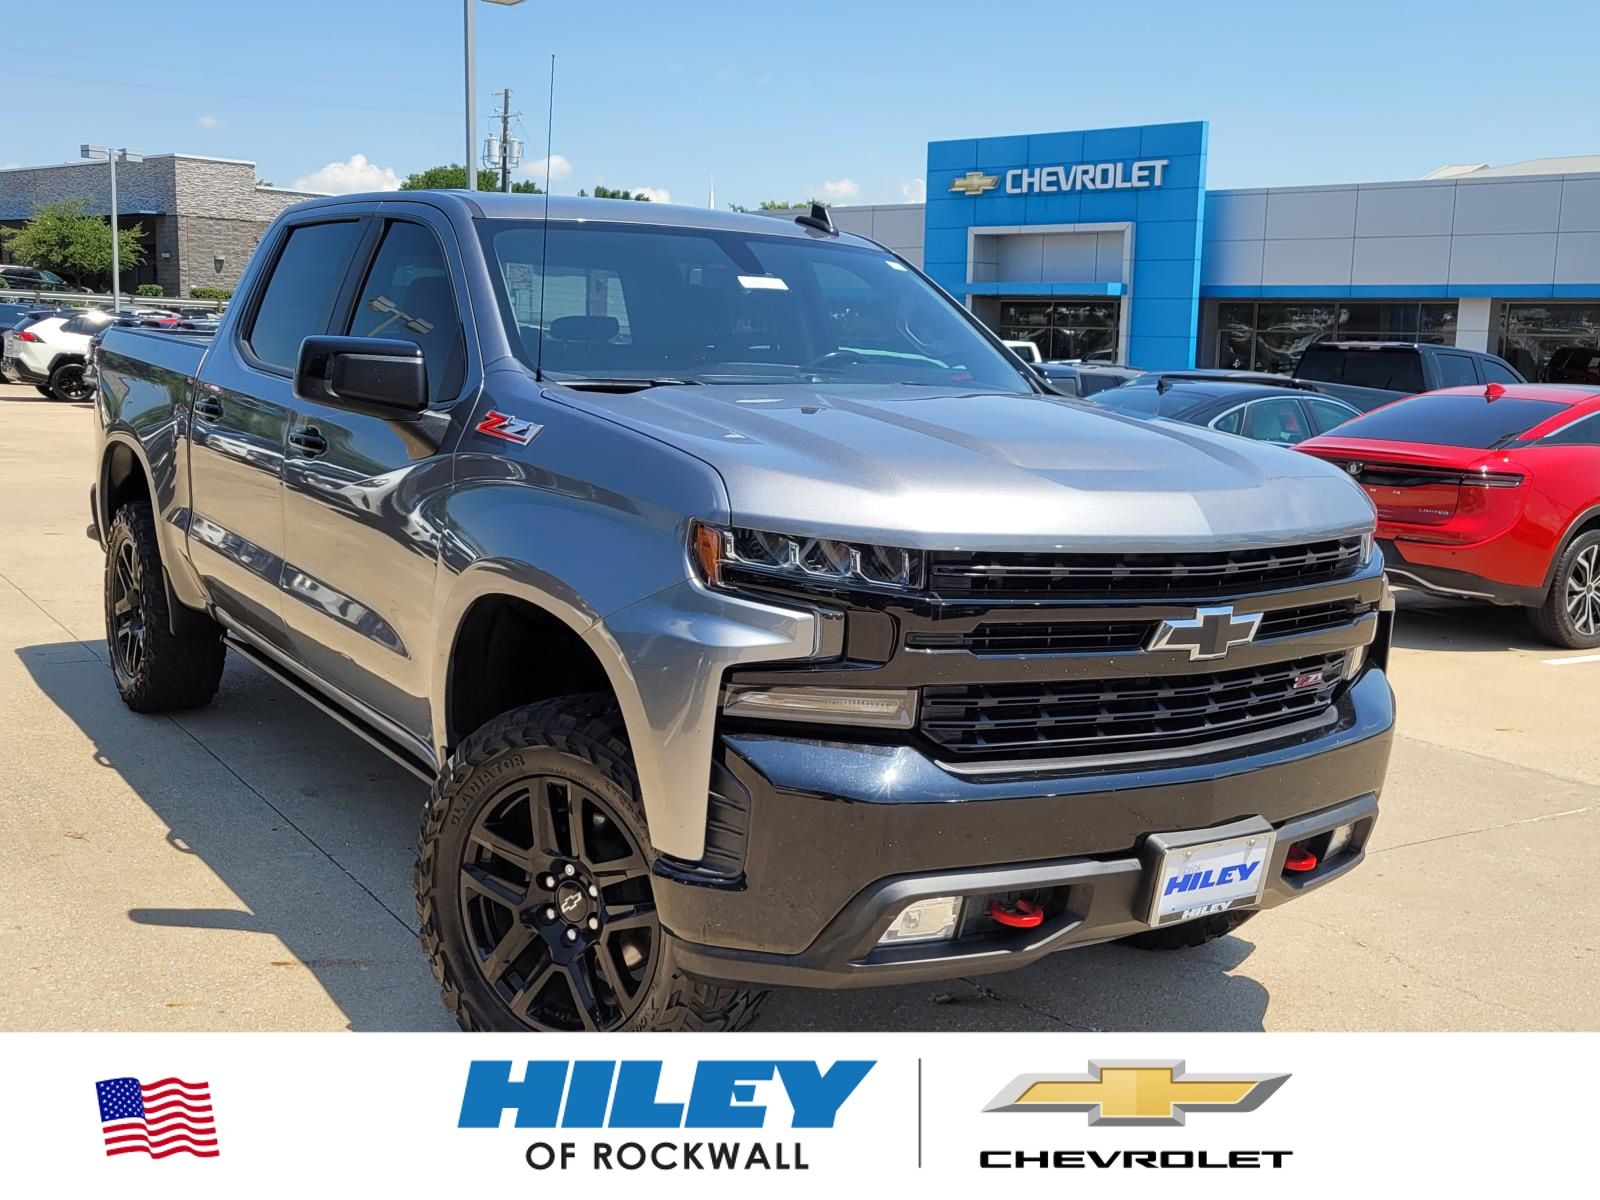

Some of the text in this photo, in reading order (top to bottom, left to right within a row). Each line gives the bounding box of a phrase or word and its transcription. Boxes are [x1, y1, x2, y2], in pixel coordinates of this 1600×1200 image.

[1005, 159, 1170, 194] CHEVROLET
[450, 754, 525, 826] GLADIATOR
[1163, 860, 1261, 896] HILEY
[1181, 900, 1233, 920] HILEY
